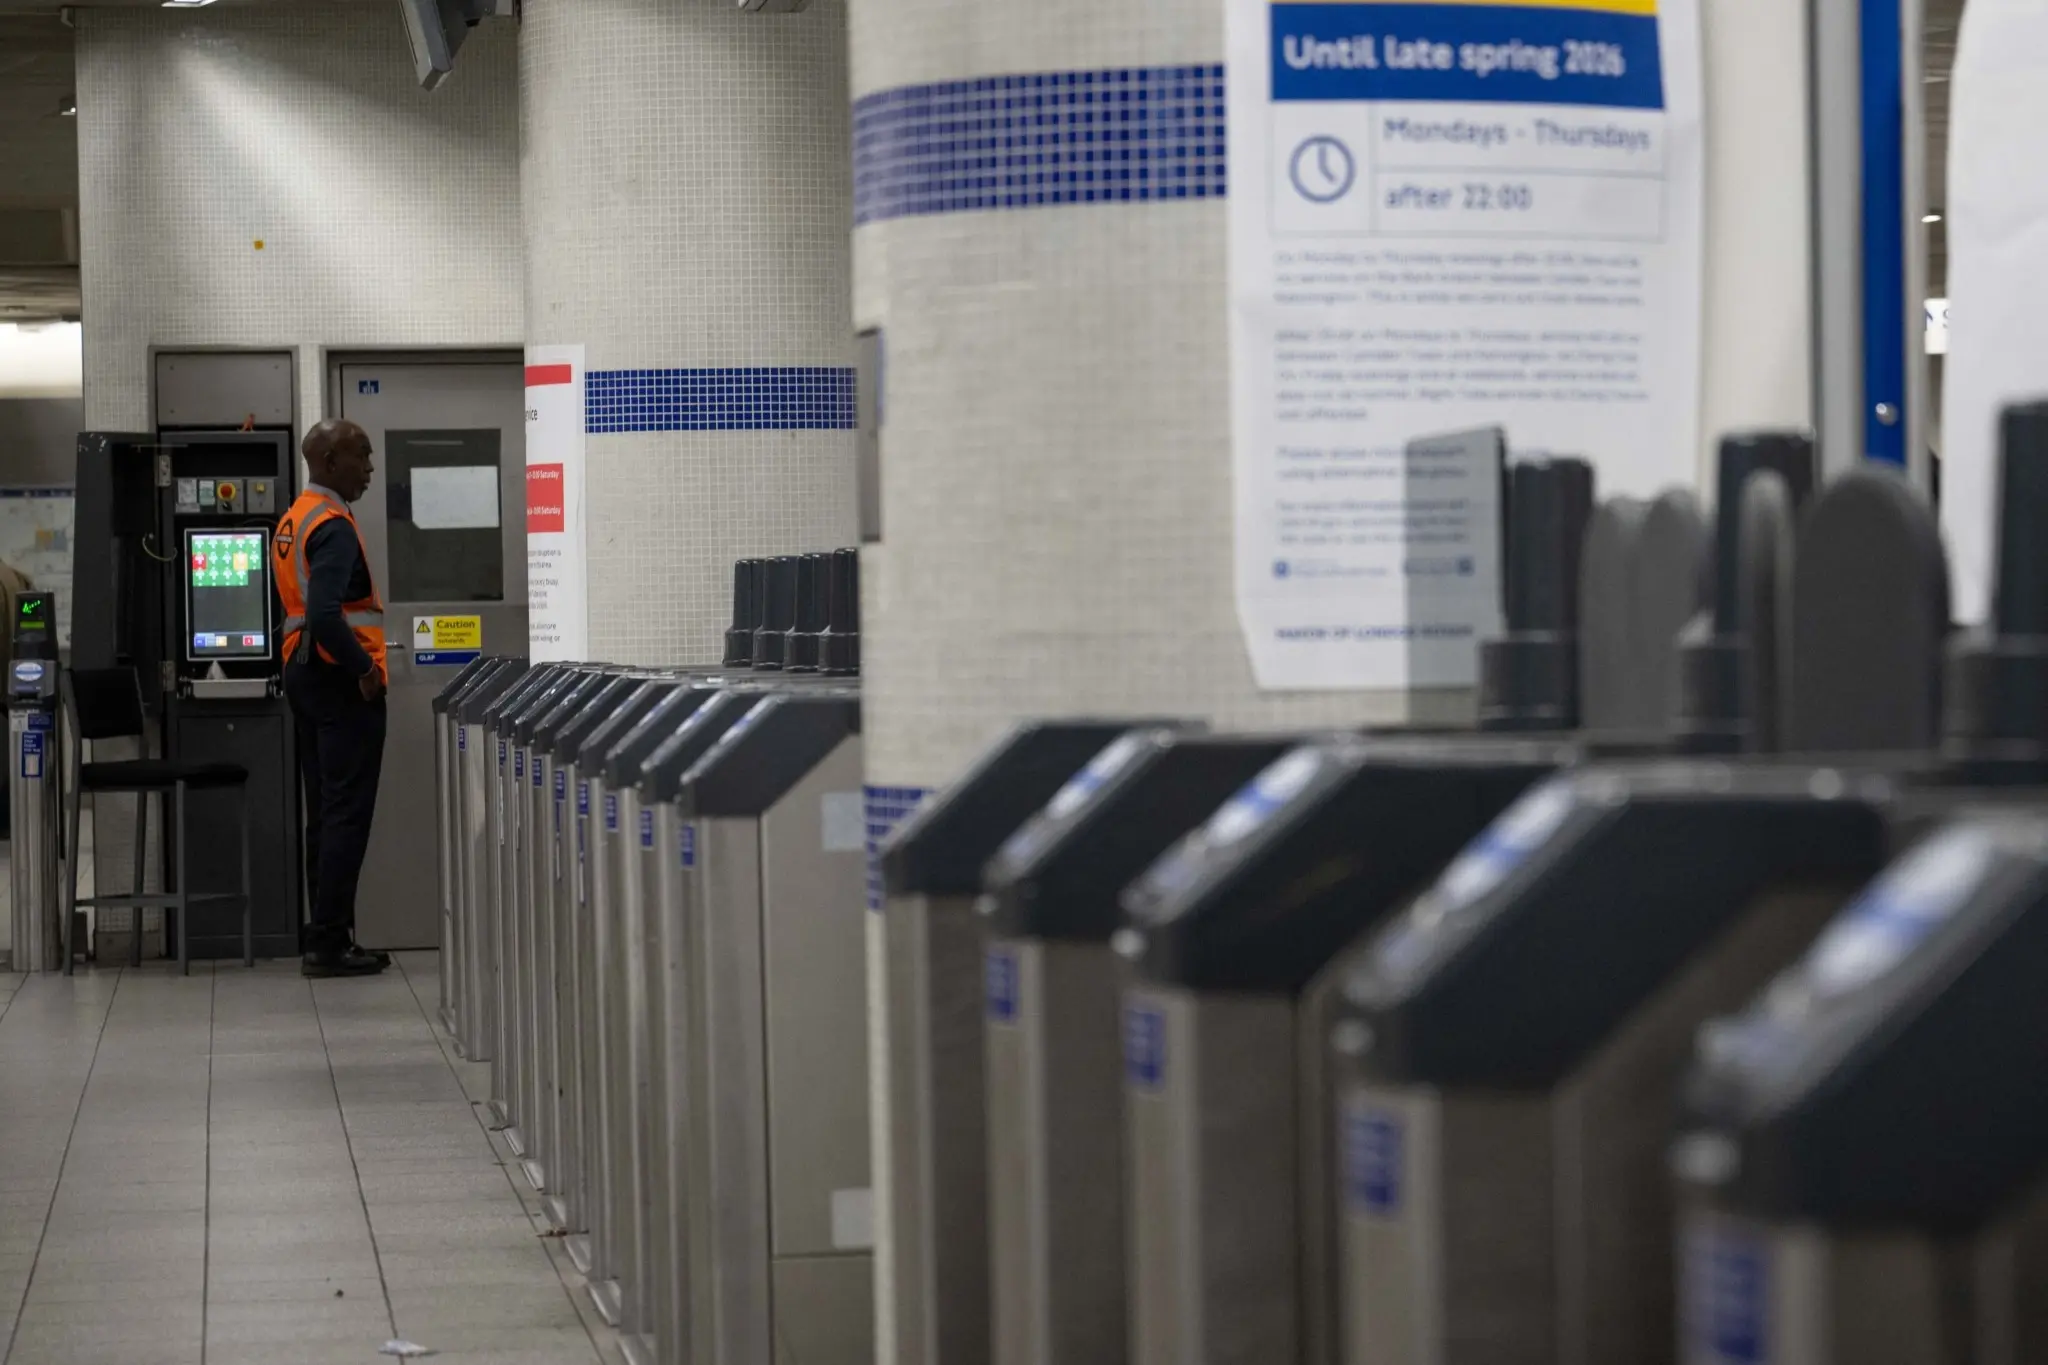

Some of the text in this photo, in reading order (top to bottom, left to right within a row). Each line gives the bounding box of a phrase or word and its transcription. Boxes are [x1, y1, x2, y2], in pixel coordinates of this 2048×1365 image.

[1283, 35, 1378, 69] Until
[1383, 35, 1454, 70] late
[1459, 39, 1559, 80] spring
[1383, 117, 1508, 148] Mondays
[1533, 119, 1650, 152] Thursdays
[1384, 182, 1452, 209] after
[437, 620, 475, 629] Caution
